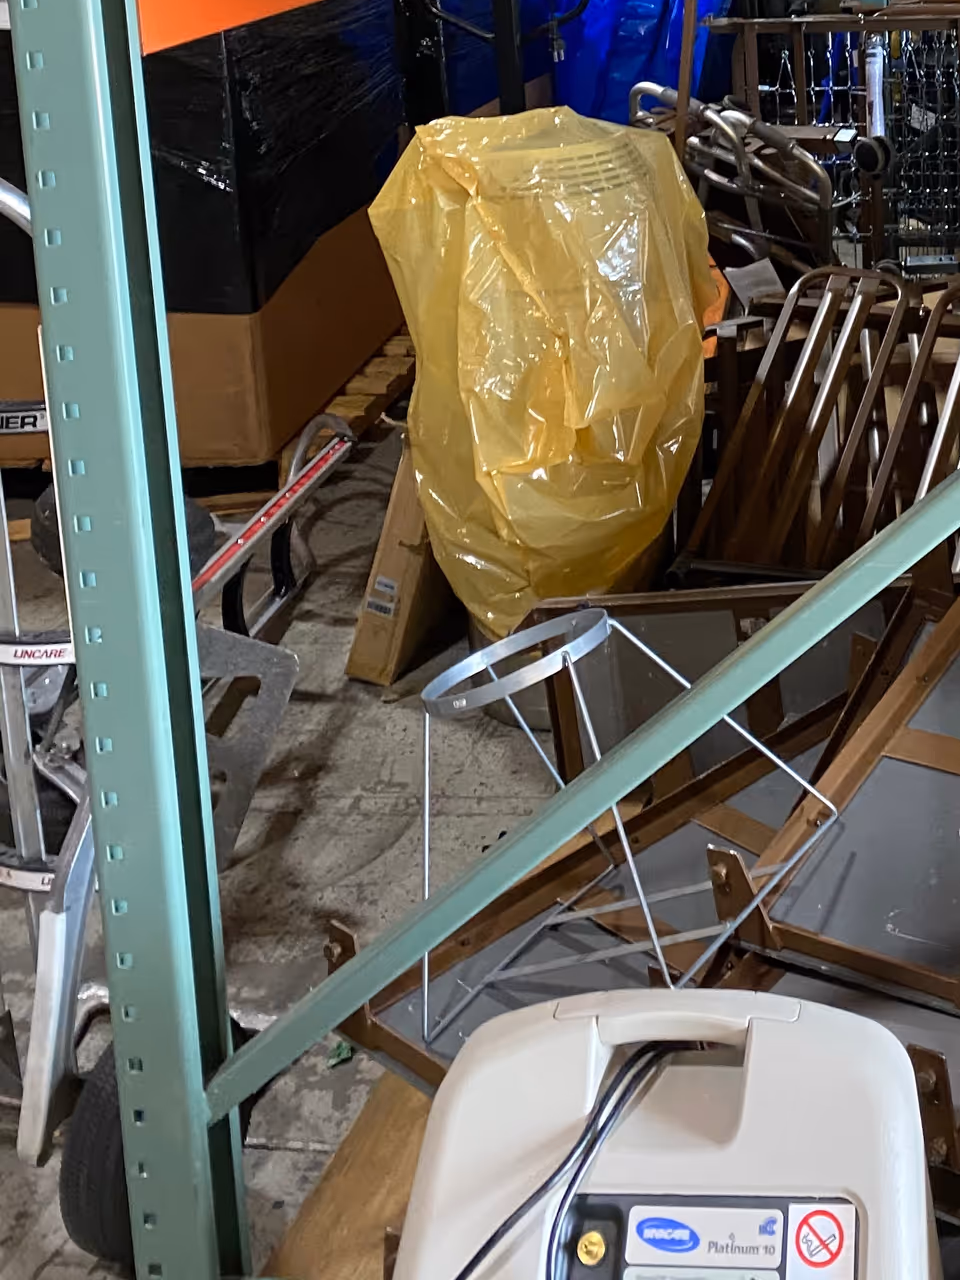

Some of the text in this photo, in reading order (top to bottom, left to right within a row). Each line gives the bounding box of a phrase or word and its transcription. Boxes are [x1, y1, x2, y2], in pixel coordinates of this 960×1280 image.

[0, 415, 37, 429] ER
[13, 648, 66, 659] LINCARE
[707, 1238, 776, 1256] Platinum 10
